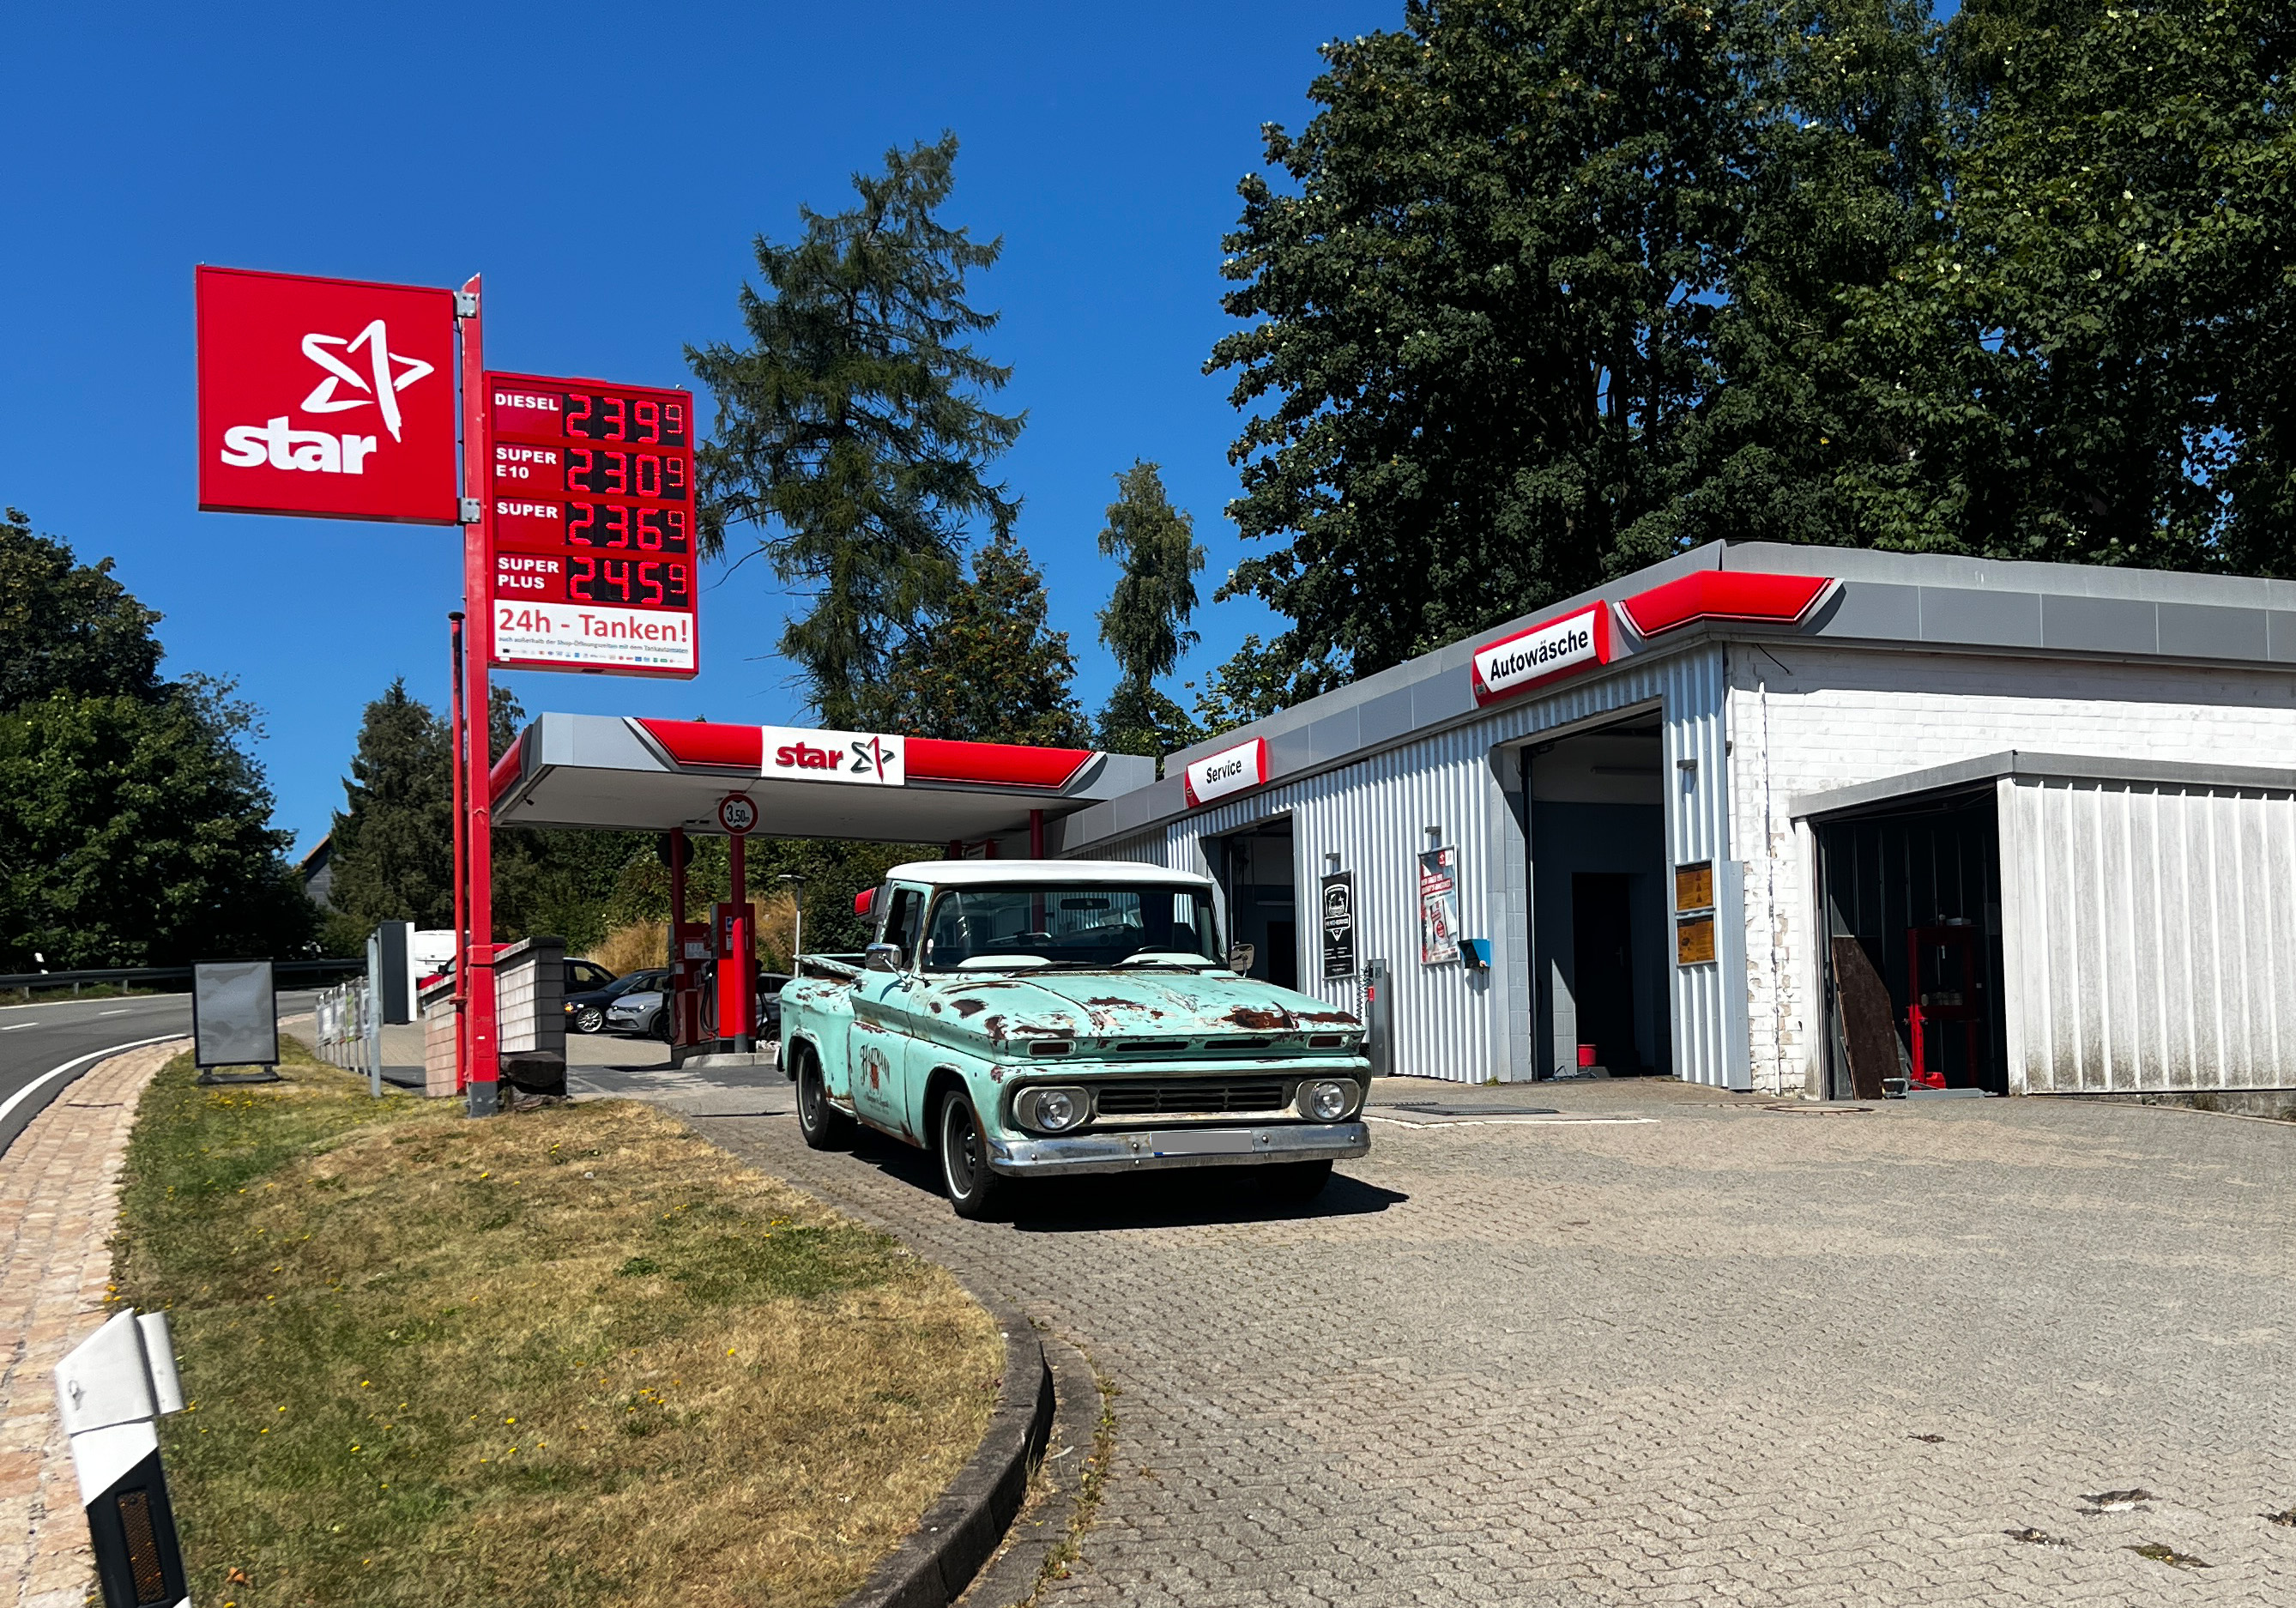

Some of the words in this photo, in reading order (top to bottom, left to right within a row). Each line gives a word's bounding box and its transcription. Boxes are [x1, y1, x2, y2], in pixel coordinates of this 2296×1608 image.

[495, 393, 559, 411] DIESEL
[221, 415, 377, 475] star
[496, 447, 557, 464] SUPER
[496, 465, 529, 479] E10
[497, 502, 558, 518] SUPER
[498, 557, 559, 573] SUPER
[498, 574, 545, 589] PLUS
[499, 608, 551, 633] 24h
[578, 614, 687, 643] Tanken!
[1490, 630, 1588, 681] Autowäsche
[776, 741, 843, 771] star
[1206, 759, 1242, 783] Service
